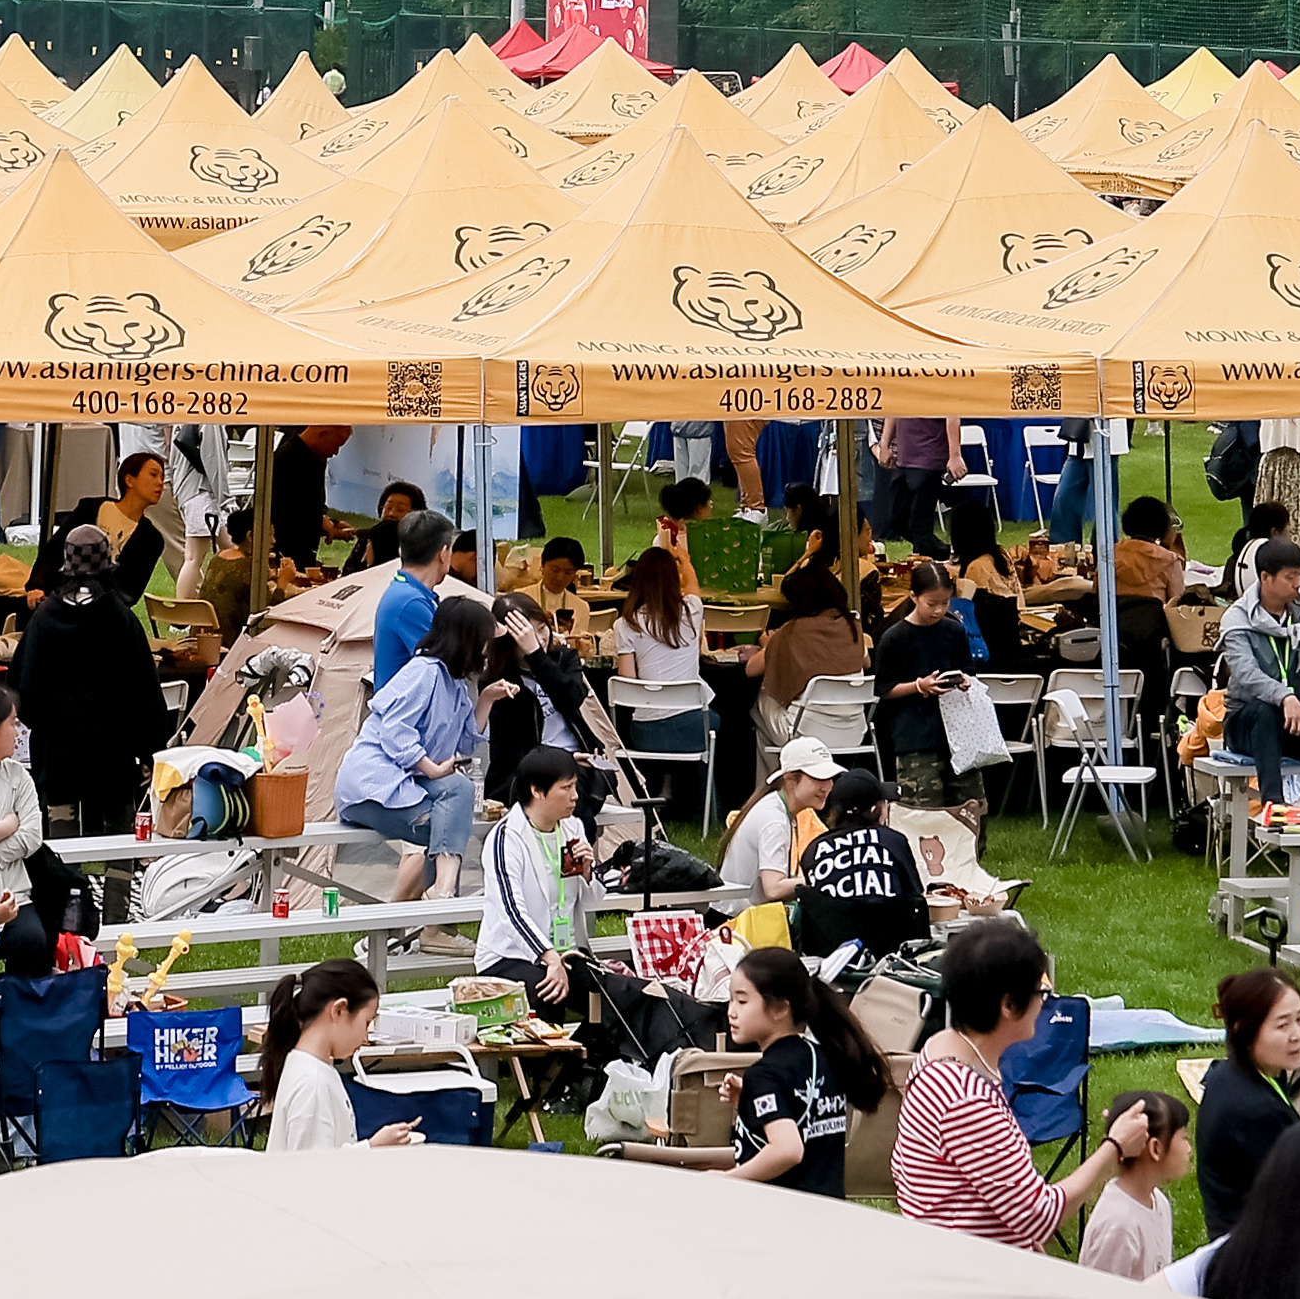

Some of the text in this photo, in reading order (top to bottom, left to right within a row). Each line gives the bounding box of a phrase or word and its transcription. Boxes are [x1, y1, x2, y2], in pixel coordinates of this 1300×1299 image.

[119, 194, 189, 204] MOVING
[205, 195, 300, 206] RELOCATIO
[1185, 330, 1282, 343] MOVING
[577, 341, 962, 362] MOVING & RELOCATION SERVICES
[517, 361, 529, 415] ASIAN TIGERS
[719, 386, 884, 413] 400-168-2882
[1133, 362, 1144, 414] ASIAN TIGERS
[72, 390, 249, 415] 400-168-2882
[814, 828, 880, 861] ANTI
[807, 846, 894, 888] SOCIAL
[188, 1061, 218, 1070] OUTDOOR
